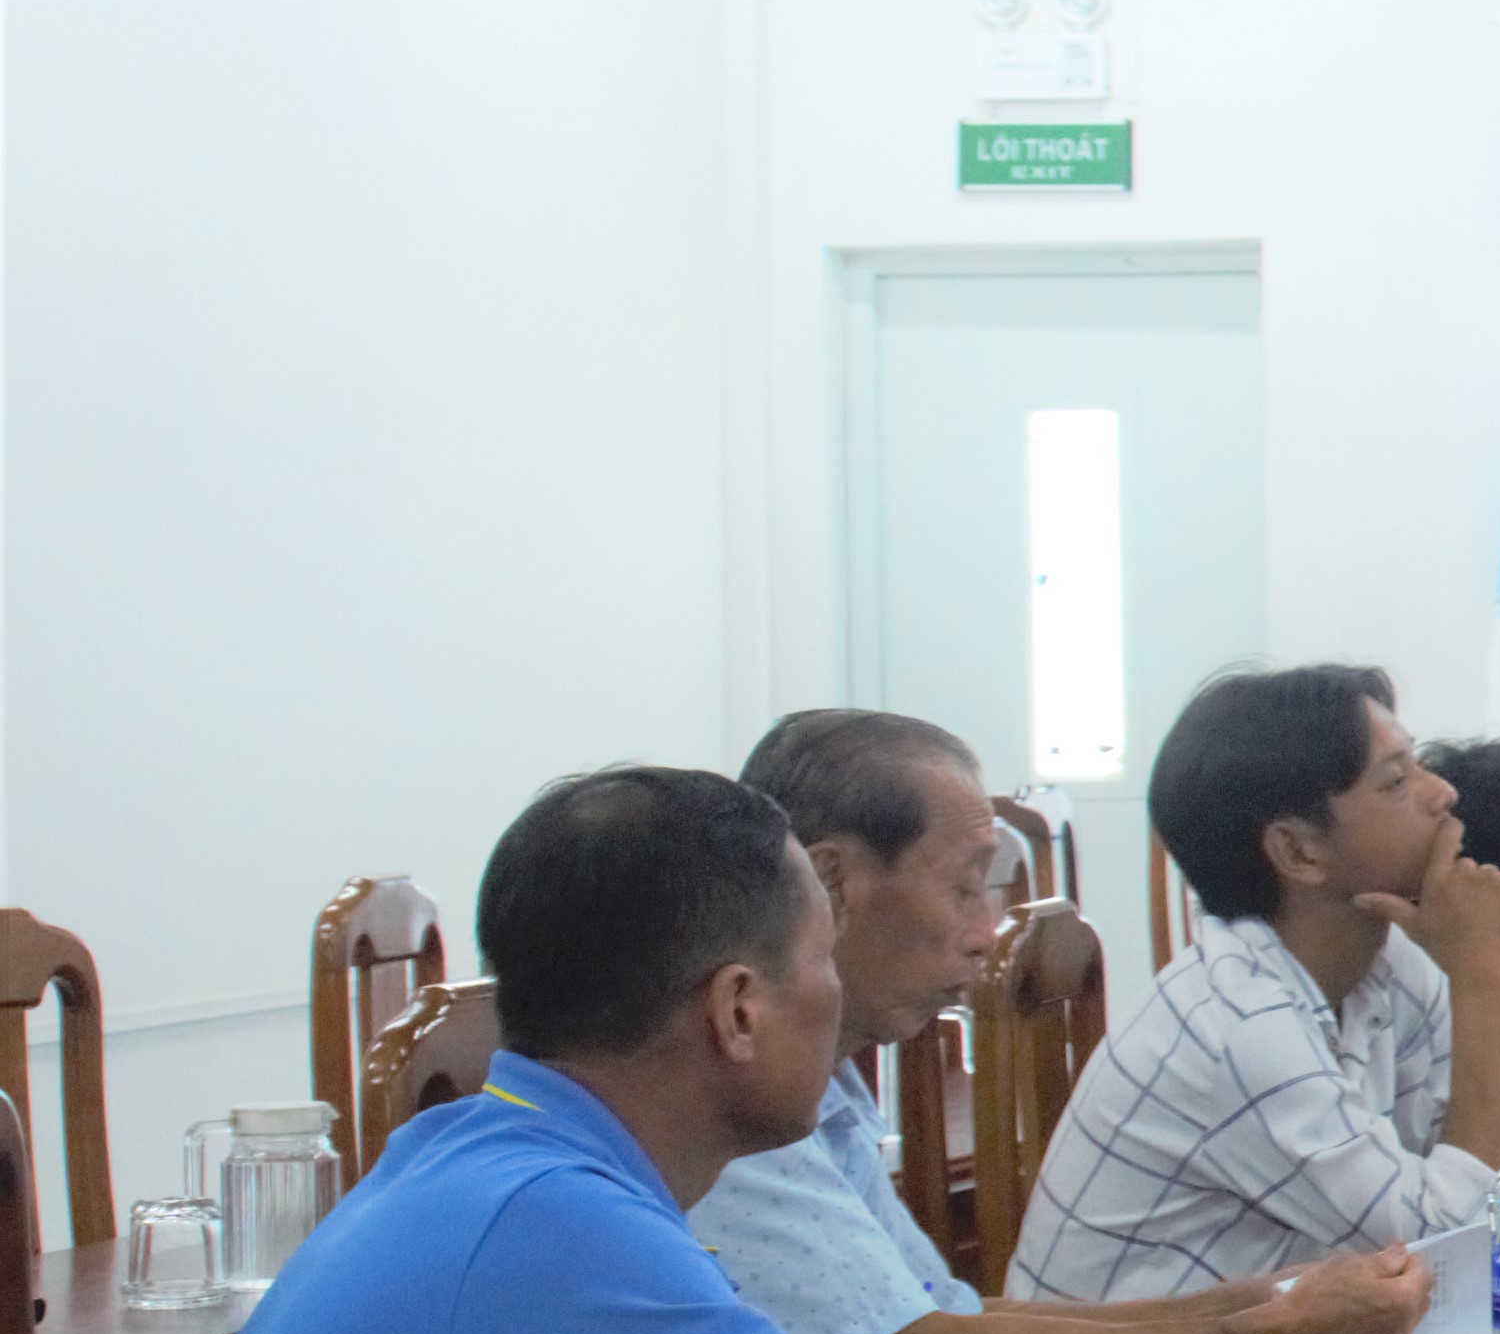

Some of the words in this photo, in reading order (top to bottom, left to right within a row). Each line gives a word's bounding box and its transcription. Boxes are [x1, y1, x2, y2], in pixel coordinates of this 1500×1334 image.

[977, 132, 1018, 161] LỐI
[1023, 132, 1109, 161] THOÁT
[1011, 166, 1072, 179] EXIT
